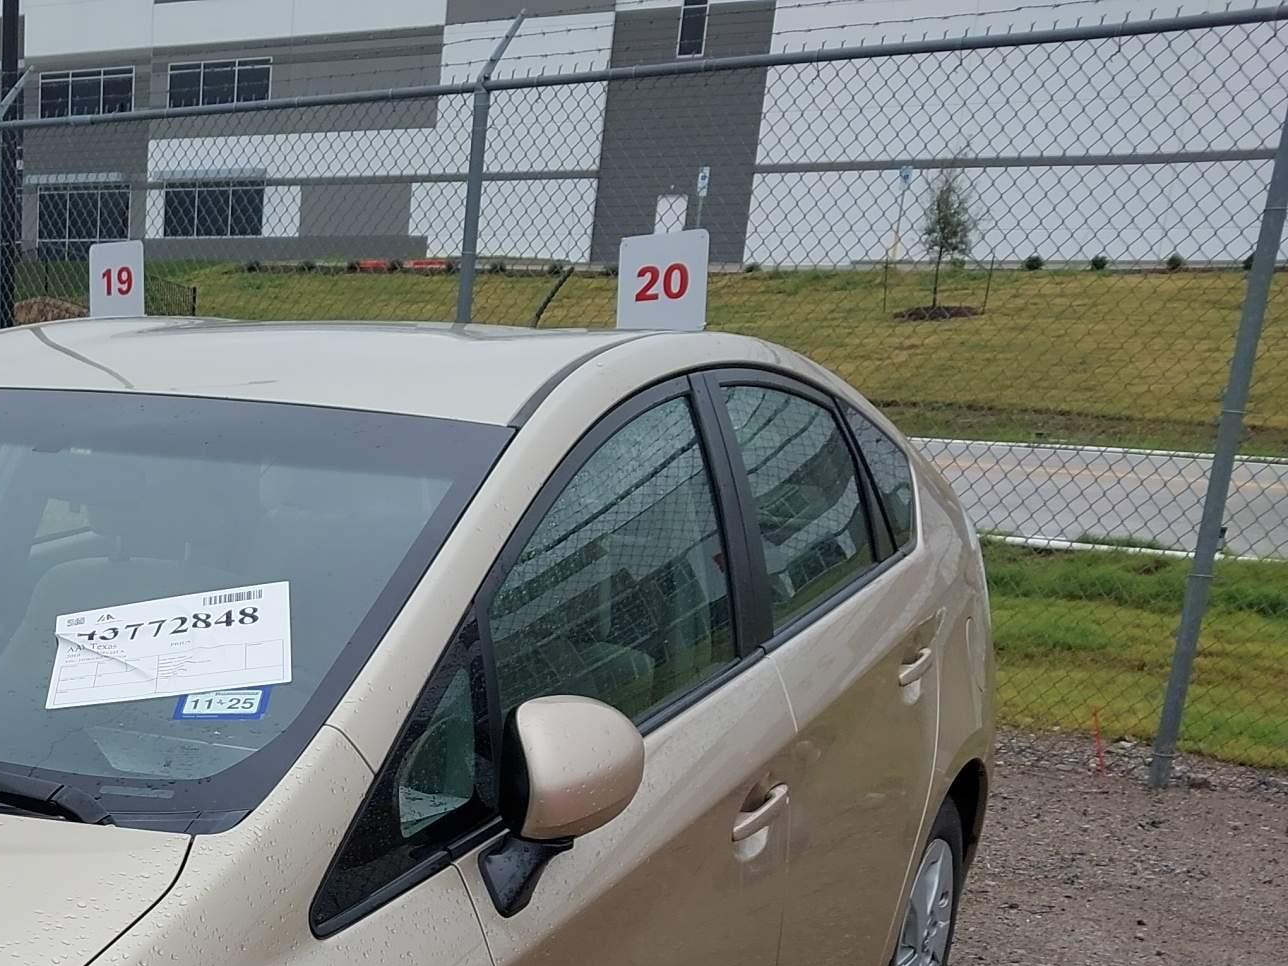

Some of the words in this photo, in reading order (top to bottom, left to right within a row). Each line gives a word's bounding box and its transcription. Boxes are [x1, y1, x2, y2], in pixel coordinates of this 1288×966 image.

[102, 266, 133, 296] 19
[635, 263, 689, 302] 20
[191, 698, 214, 710] 11
[226, 697, 255, 710] 25
